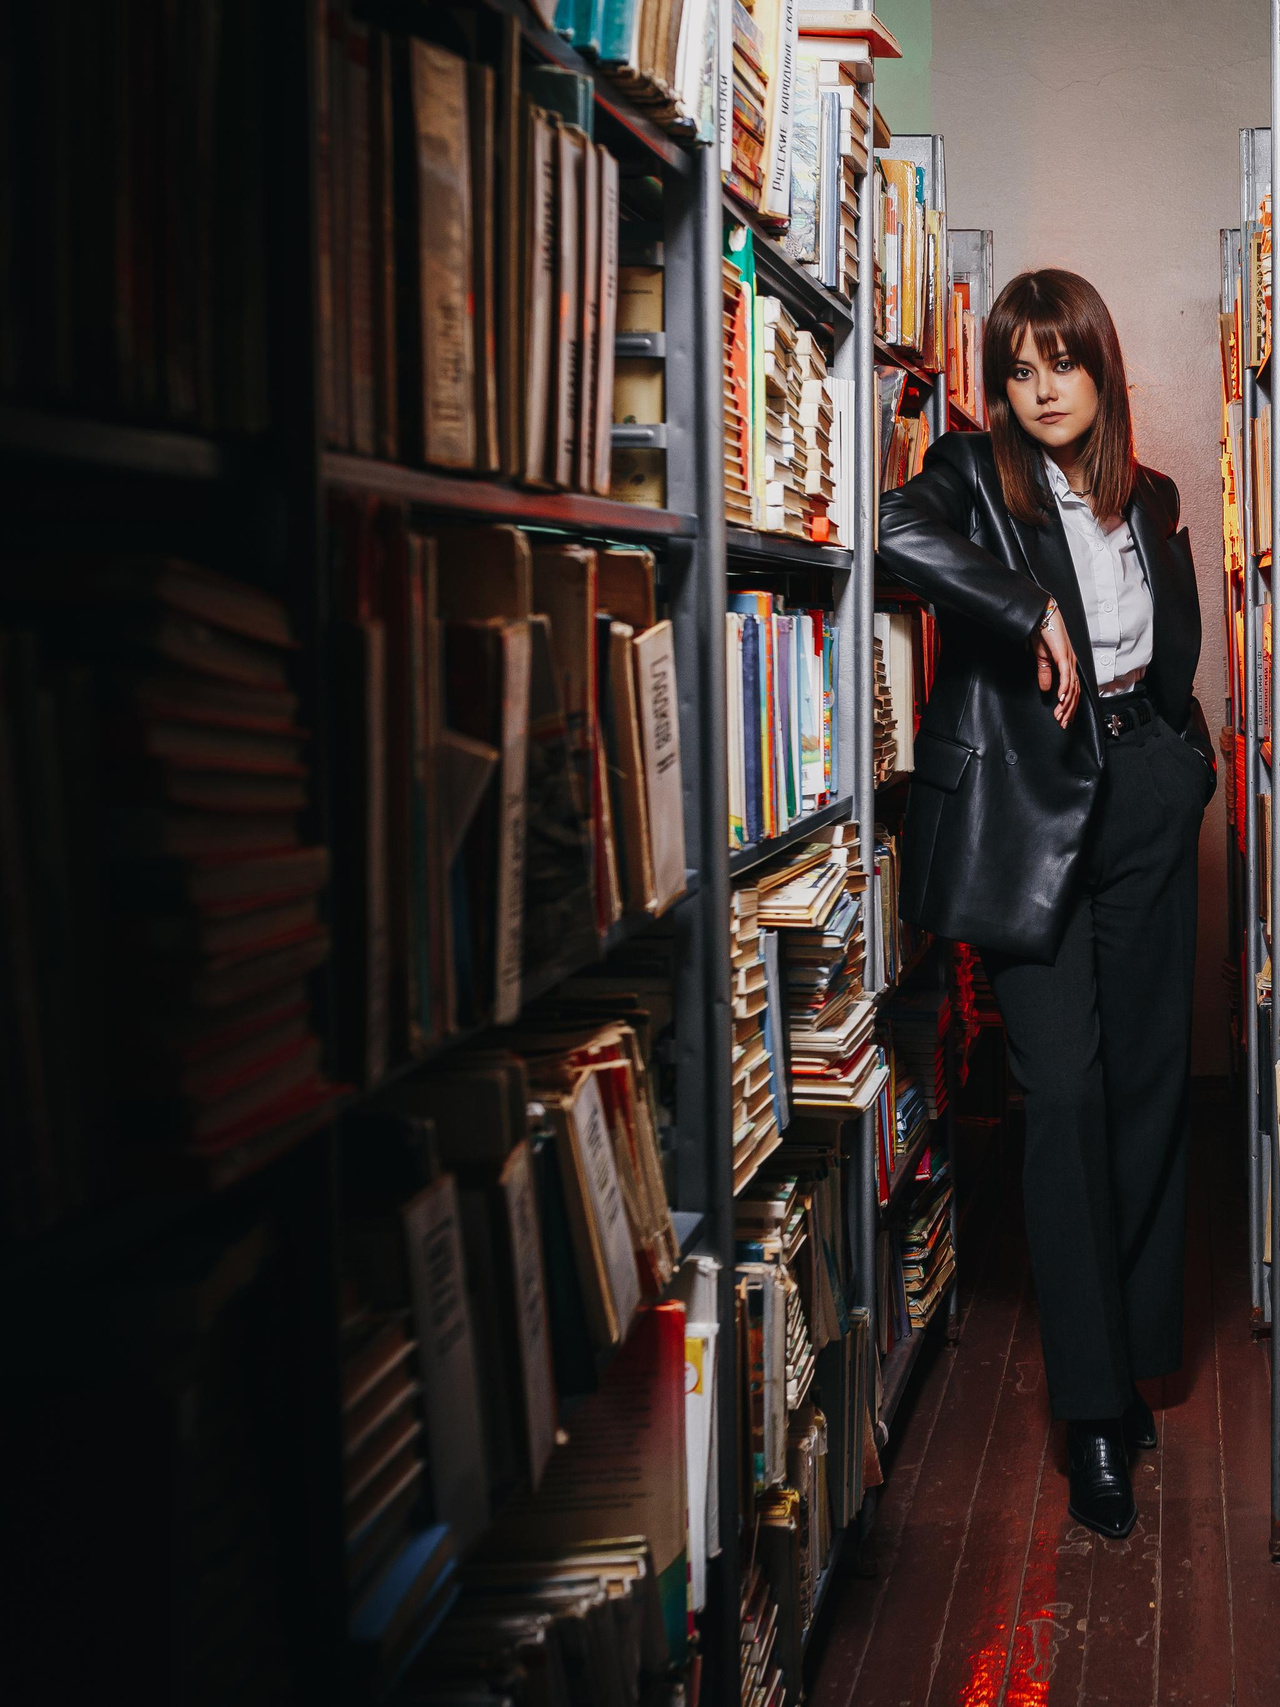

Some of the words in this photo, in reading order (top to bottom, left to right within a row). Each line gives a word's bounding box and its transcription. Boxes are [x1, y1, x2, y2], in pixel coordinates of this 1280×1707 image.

[719, 74, 728, 144] СКАЗКИ
[772, 124, 788, 192] РУССКИЕ
[781, 41, 793, 115] НАРОДНЫЕ
